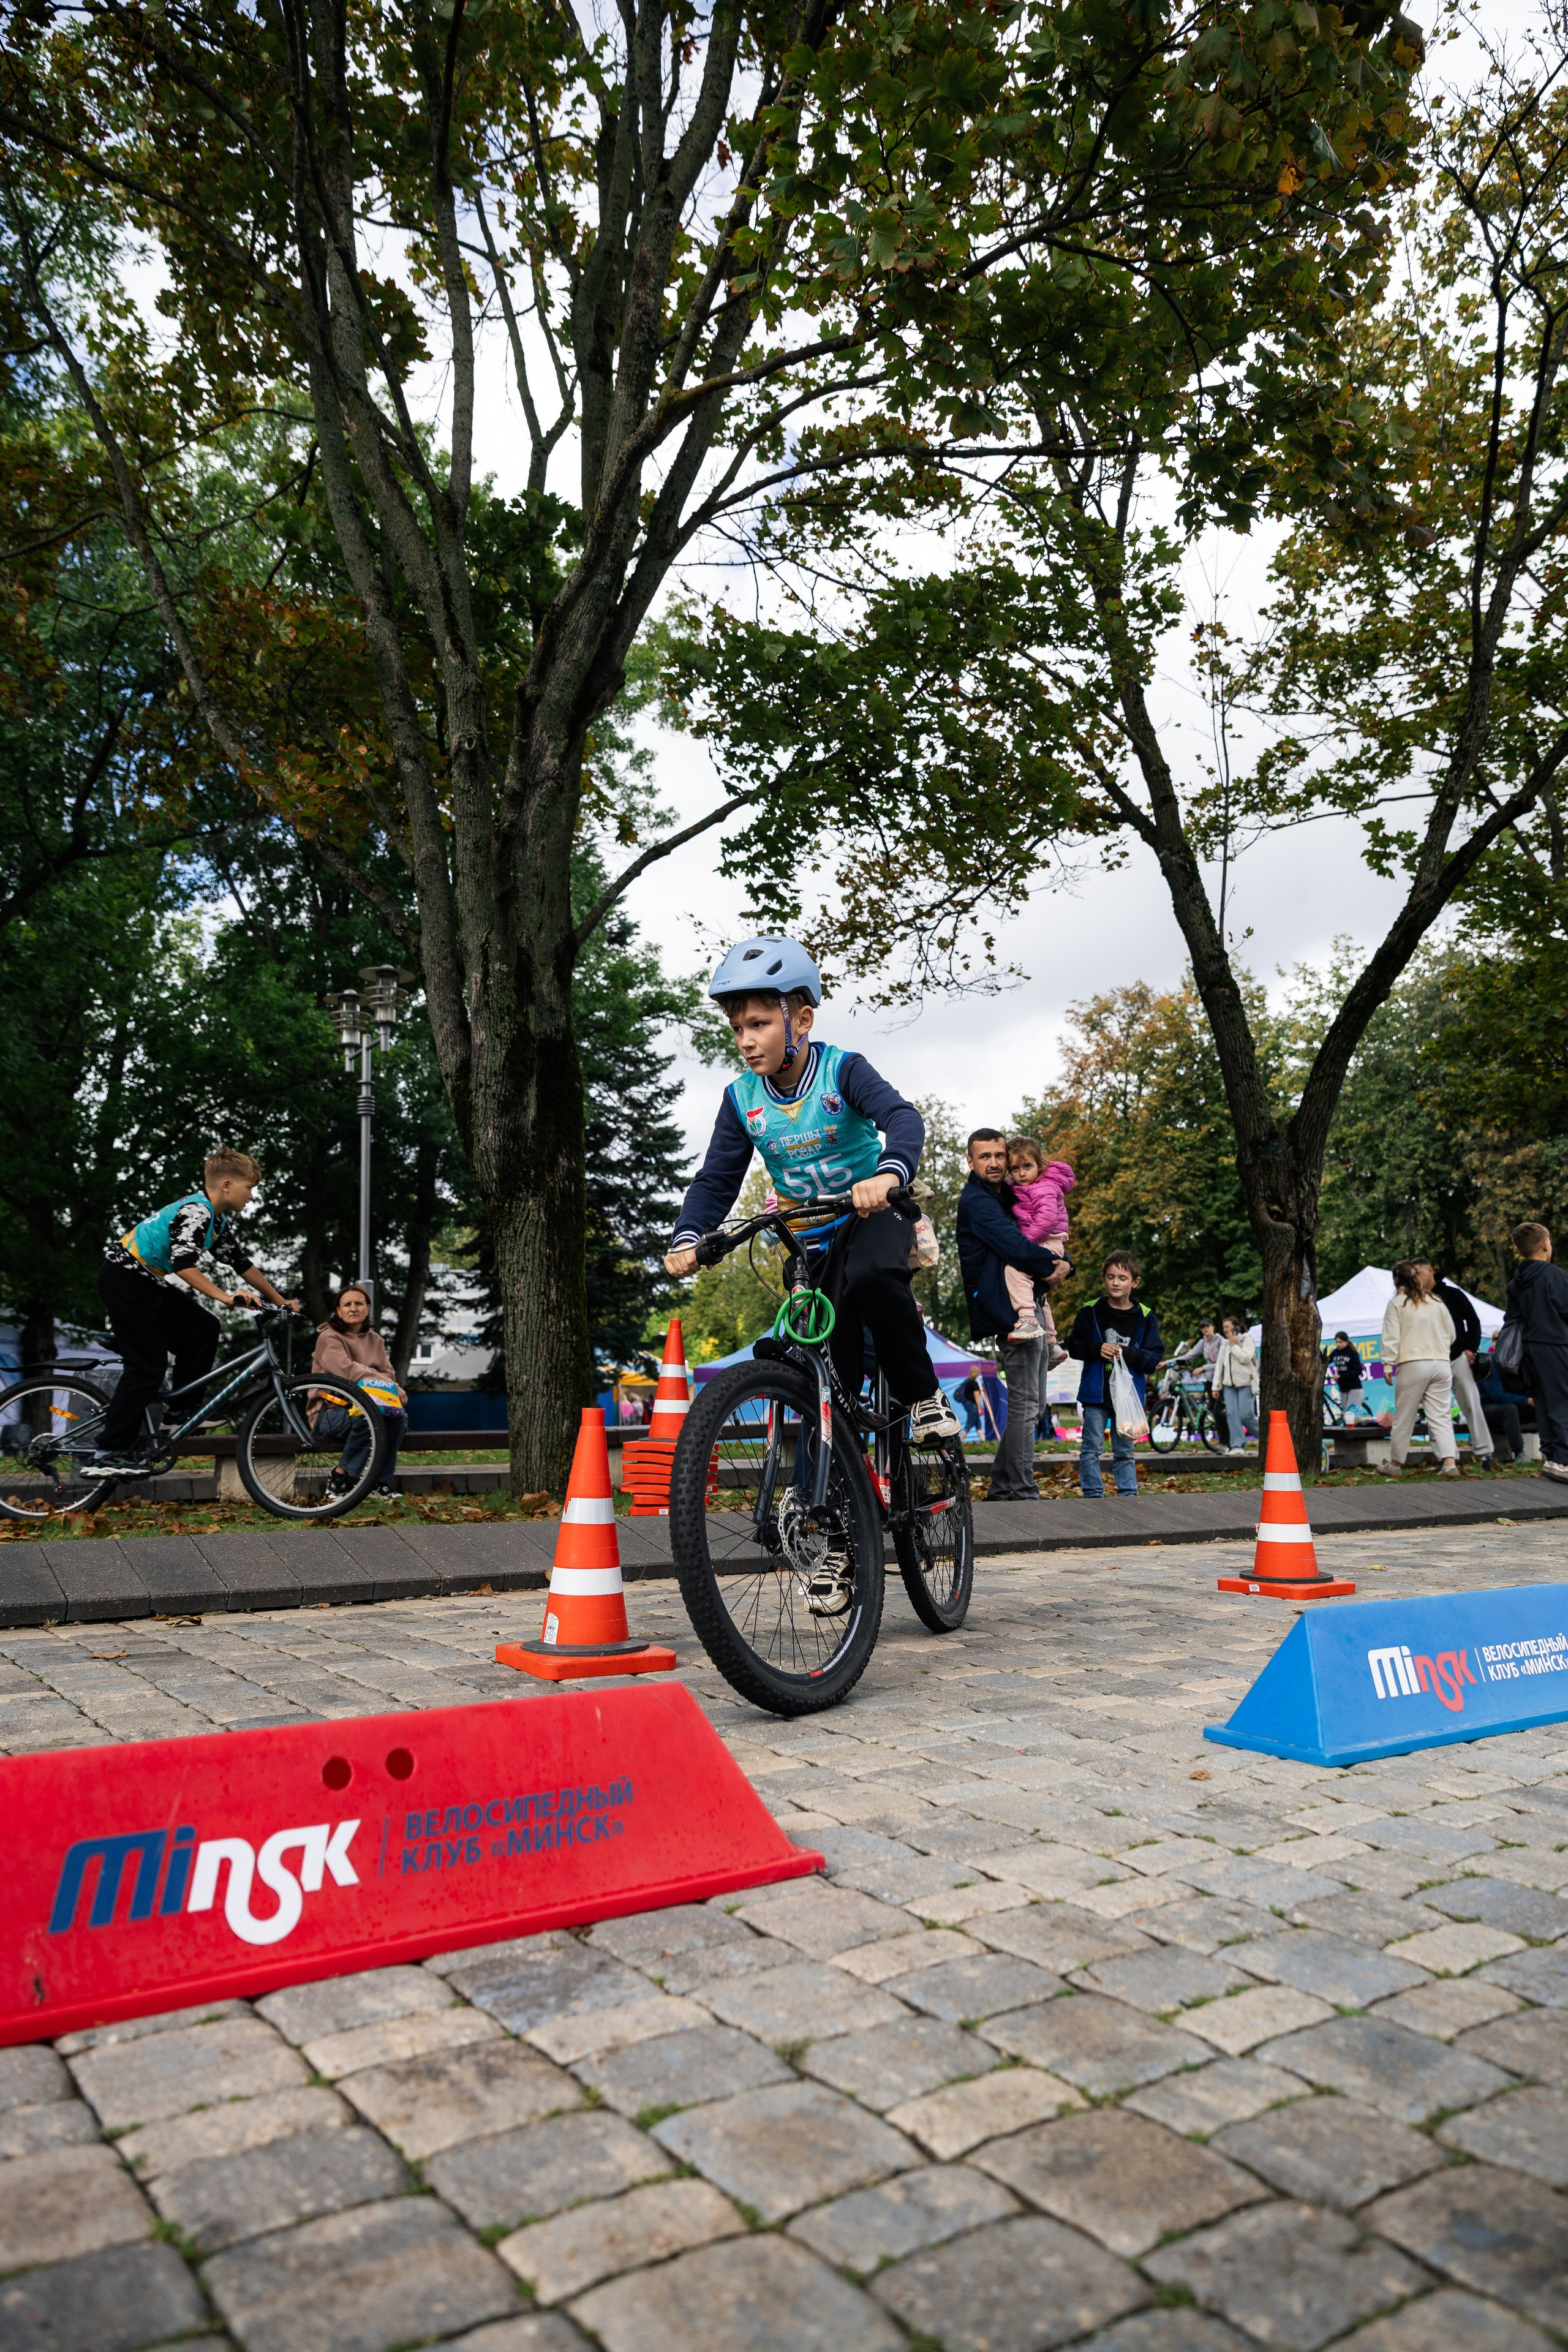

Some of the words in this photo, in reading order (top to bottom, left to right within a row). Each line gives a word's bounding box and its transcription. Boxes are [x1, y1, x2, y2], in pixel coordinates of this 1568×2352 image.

[779, 1129, 822, 1147] ПЕРШЫ
[787, 1144, 822, 1159] РОВАР
[782, 1152, 853, 1199] 515
[1482, 1632, 1568, 1663] ВЕЛОСИПЕДНЫЙ
[1487, 1662, 1520, 1681] КЛУБ
[405, 1774, 633, 1841] ВЕЛОСИПЕДНЫЙ
[401, 1839, 481, 1875] КЛУБ
[490, 1813, 625, 1857] «МИНСК»
